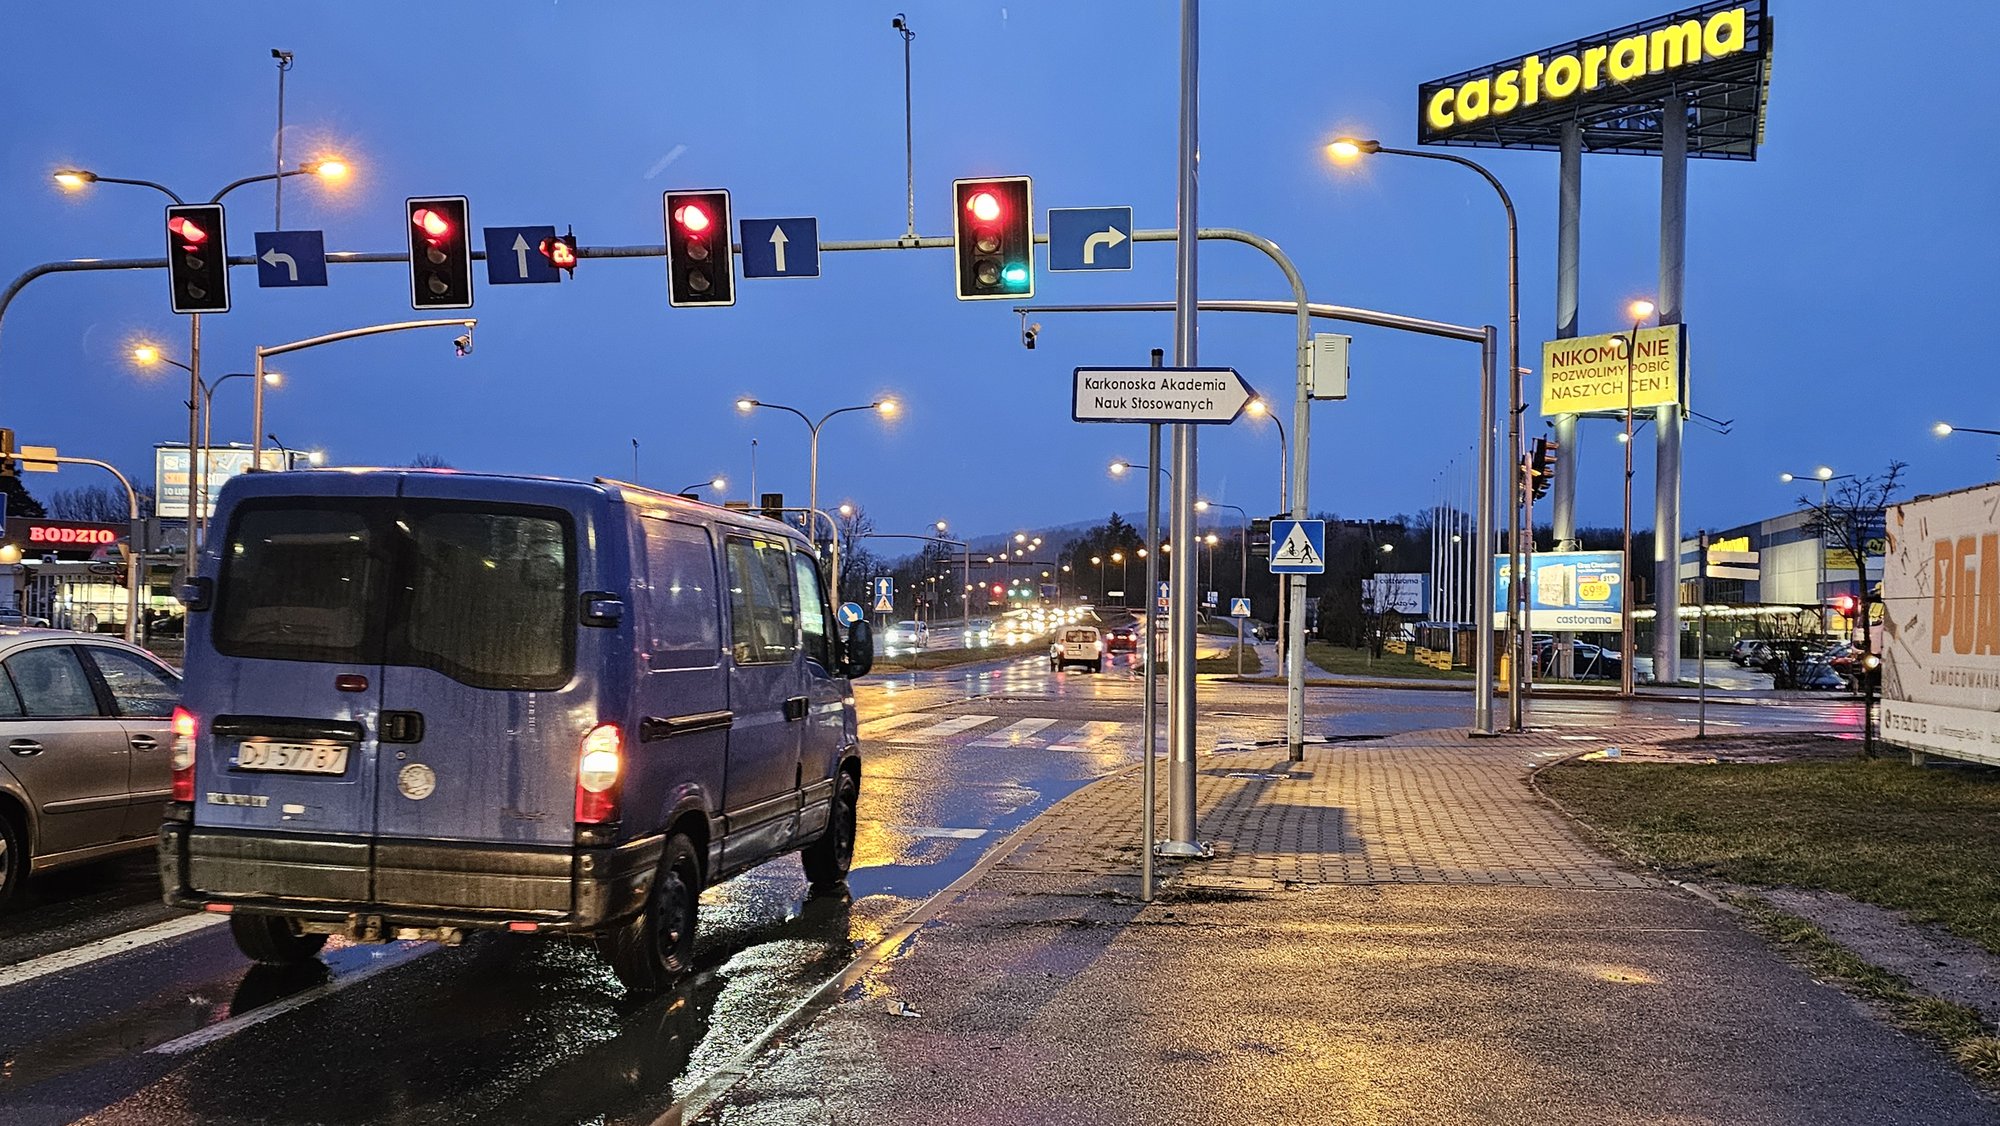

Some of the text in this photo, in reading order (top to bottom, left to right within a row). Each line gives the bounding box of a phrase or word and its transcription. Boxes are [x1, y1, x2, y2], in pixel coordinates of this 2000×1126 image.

[1428, 8, 1745, 128] castorama
[1552, 339, 1669, 368] NIKOMU NIE
[1552, 365, 1626, 382] POZWOLIMY
[1085, 378, 1226, 391] Karkonoska Akademia
[1551, 381, 1623, 399] NASZYCH
[1631, 377, 1660, 392] CEN
[1095, 397, 1213, 412] Nauk Stosowanych
[29, 527, 115, 543] BODZIO
[1556, 613, 1612, 625] castorama
[241, 744, 344, 769] DJ 57787
